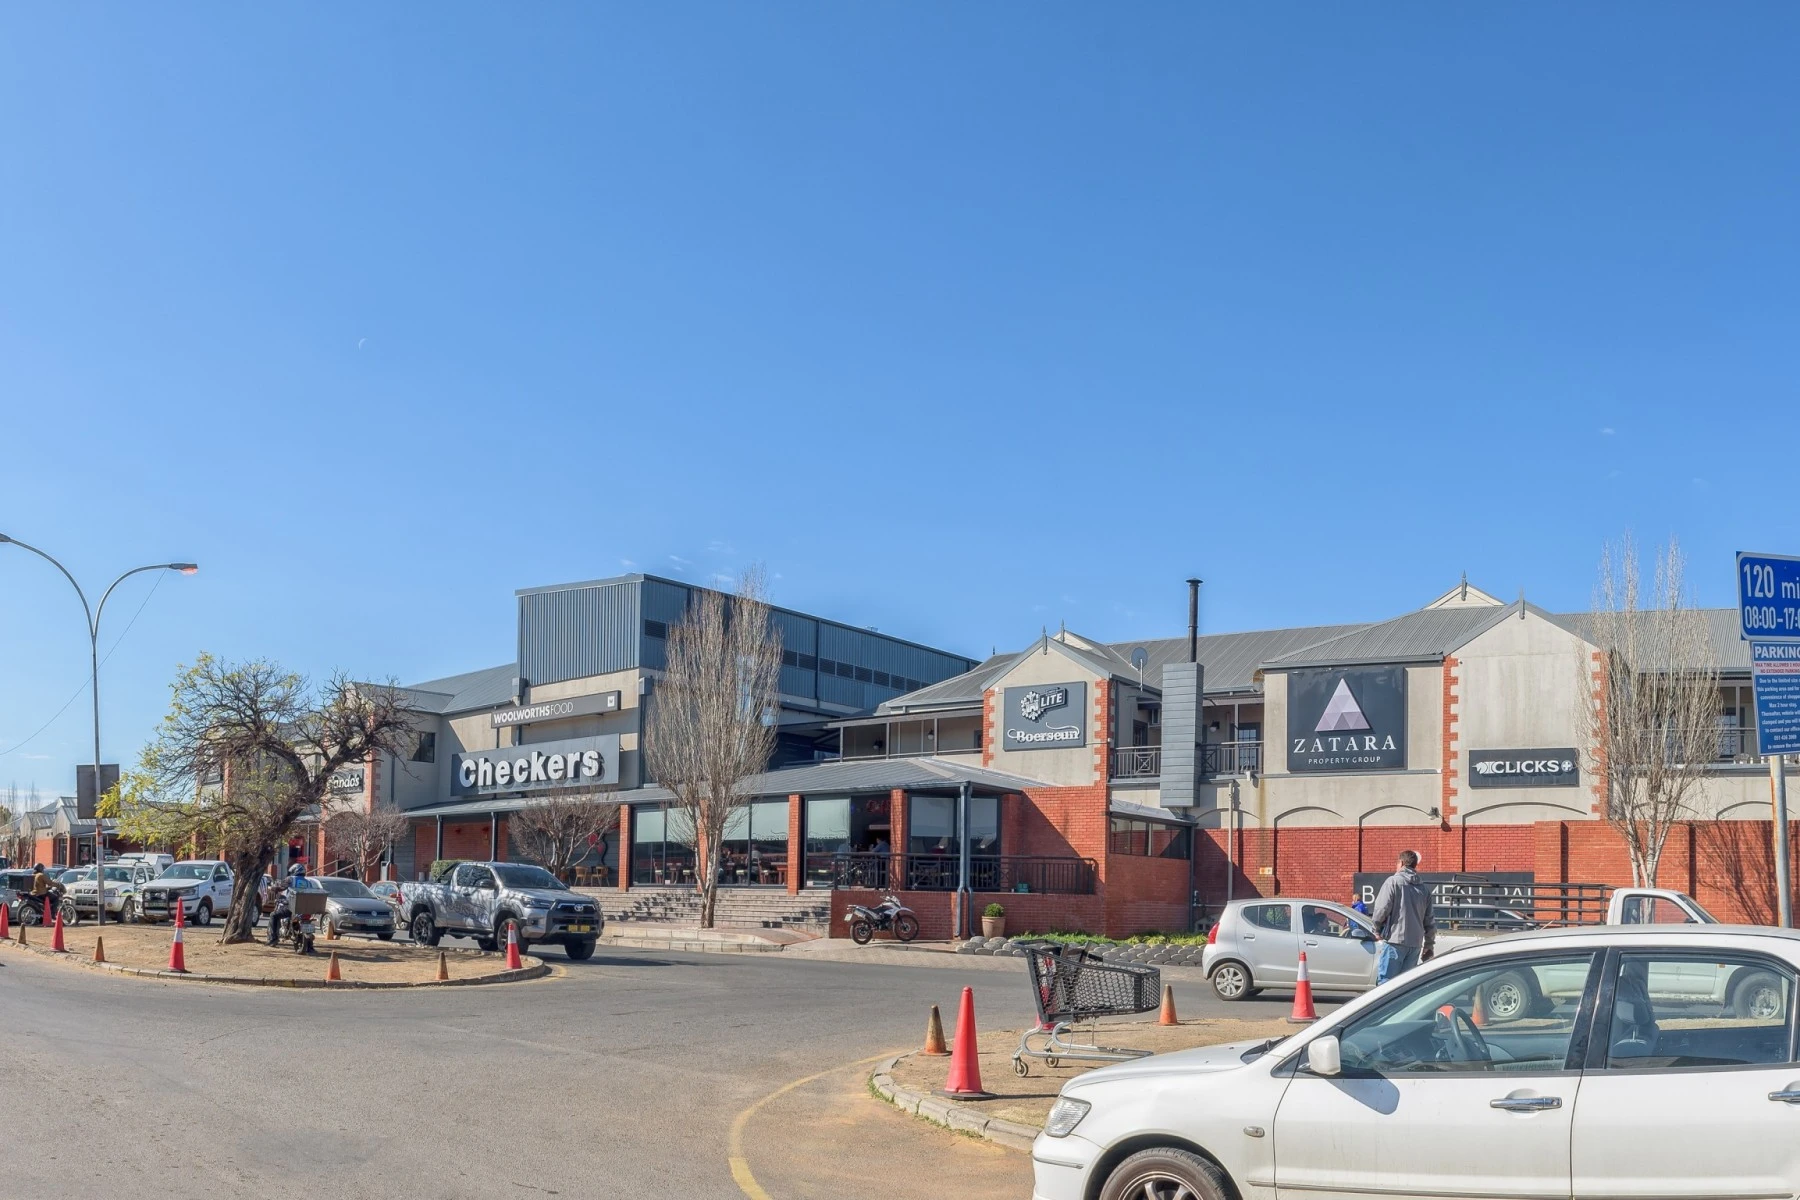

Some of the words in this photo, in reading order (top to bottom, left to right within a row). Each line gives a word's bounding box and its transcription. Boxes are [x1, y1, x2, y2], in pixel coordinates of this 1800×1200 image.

[1744, 563, 1775, 598] 120
[1041, 692, 1063, 707] LITE
[1007, 729, 1080, 742] Boerseun
[1293, 735, 1397, 753] ZATARA
[1308, 757, 1350, 765] PROPERTY
[1352, 755, 1381, 764] GROUP
[1491, 760, 1560, 774] CLICKS
[459, 750, 600, 788] Checkers
